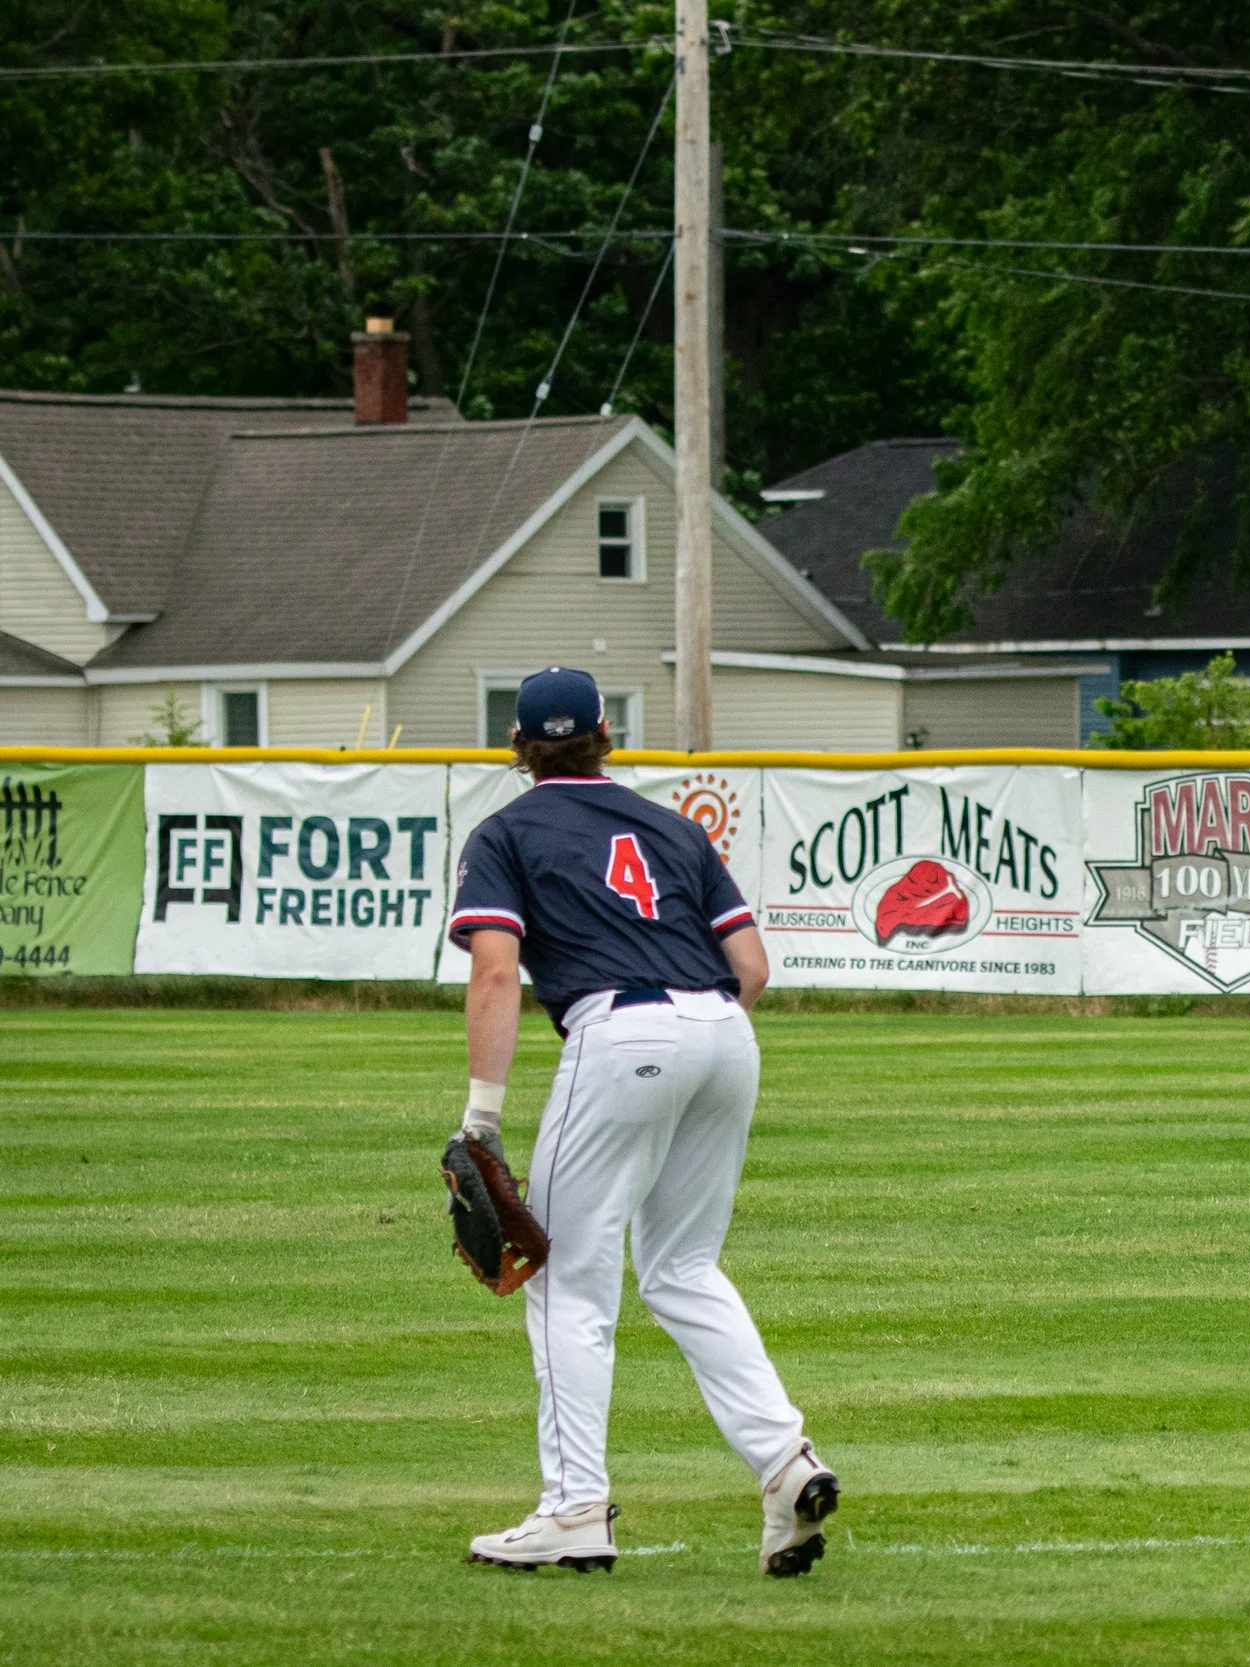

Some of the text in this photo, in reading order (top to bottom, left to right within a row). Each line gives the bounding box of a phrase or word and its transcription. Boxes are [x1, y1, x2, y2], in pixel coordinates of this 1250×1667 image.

[257, 815, 438, 881] FORT
[789, 783, 1059, 900] SCOTT MEATS
[23, 869, 87, 897] Fence
[605, 832, 660, 920] 4
[1115, 886, 1146, 901] 1916
[1155, 864, 1223, 899] 100
[255, 887, 432, 928] FREIGHT
[768, 911, 1074, 932] MUSKEGON HEIGHTS
[783, 956, 1056, 976] CATERING TO THE CARNIVORE SINCE 1983
